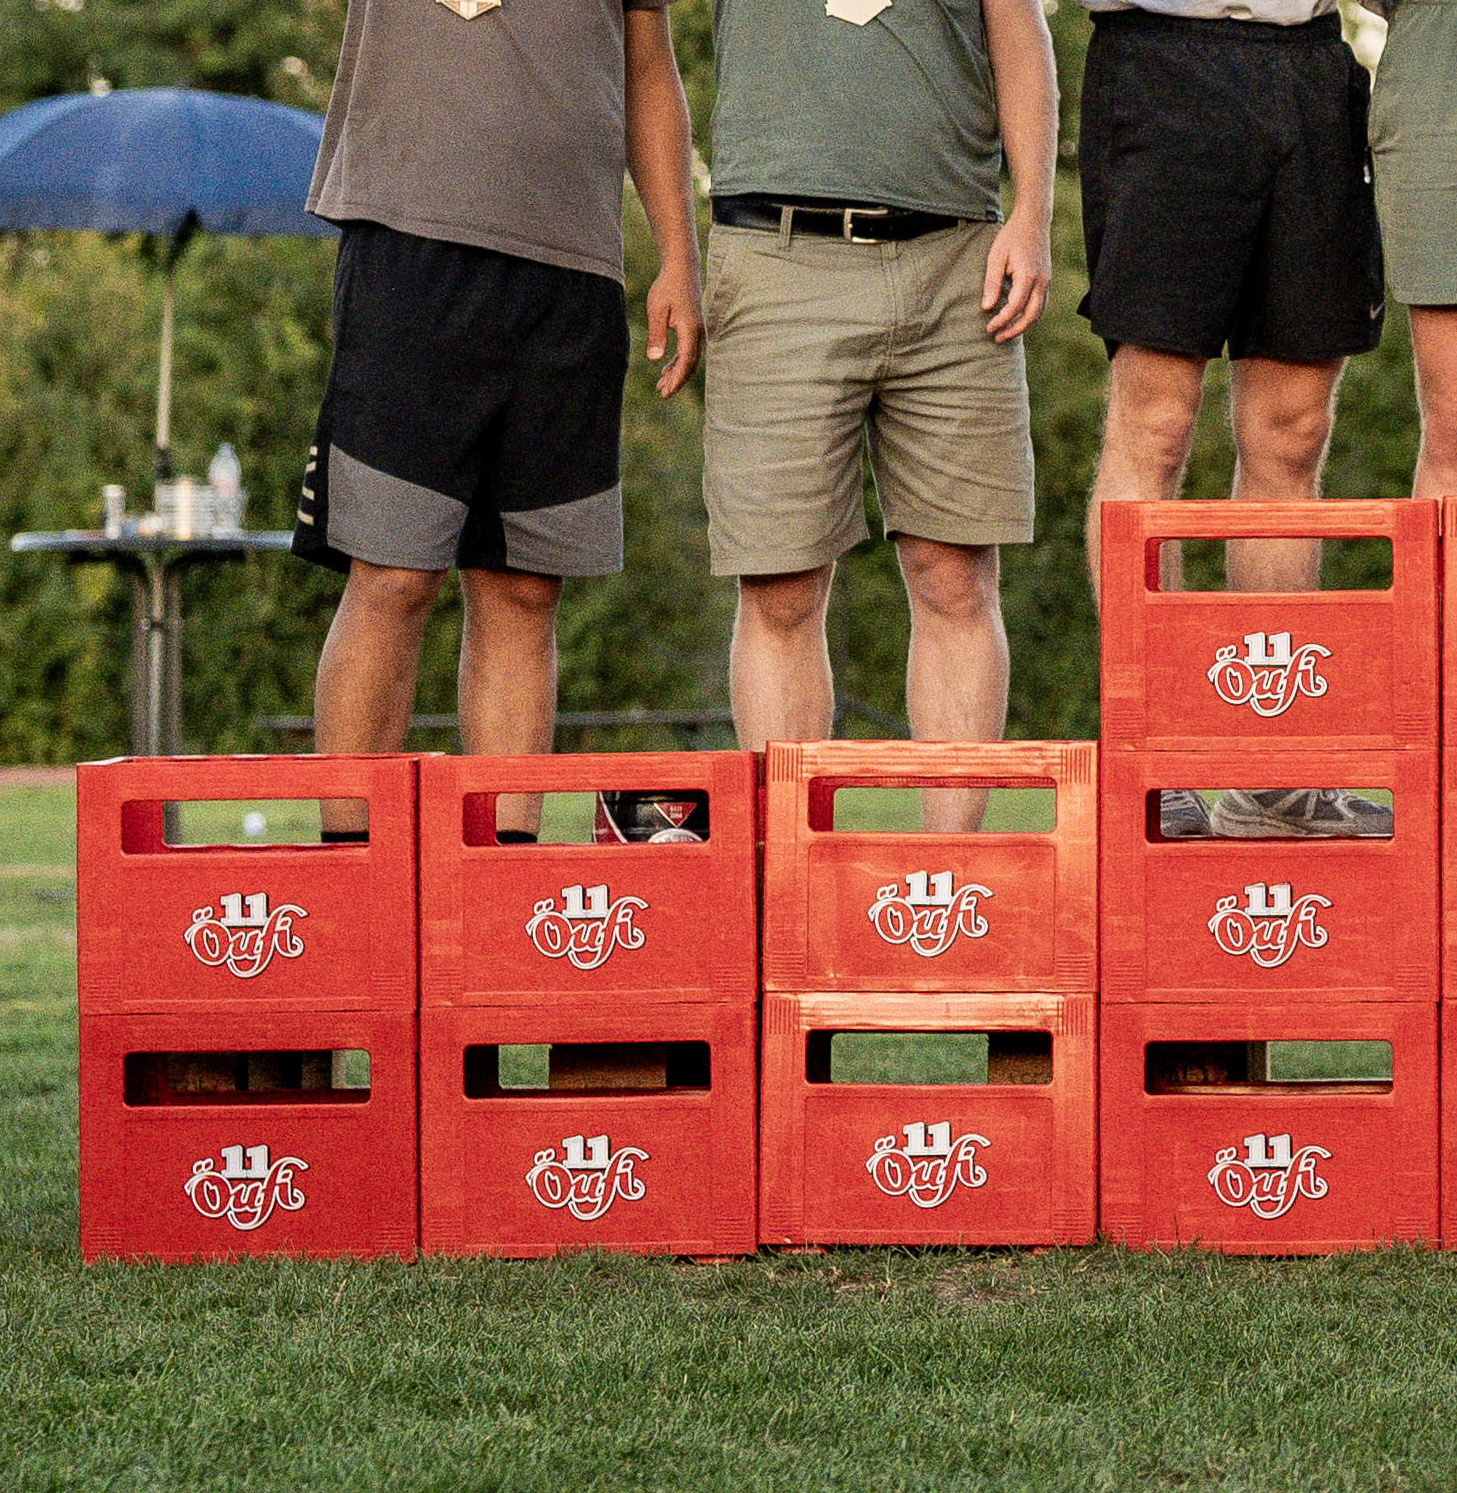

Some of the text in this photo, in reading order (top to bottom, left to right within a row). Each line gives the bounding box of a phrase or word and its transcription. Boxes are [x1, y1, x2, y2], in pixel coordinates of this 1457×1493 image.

[1244, 631, 1293, 666] 11
[562, 884, 611, 919] 11
[904, 870, 953, 905] 11
[1244, 882, 1293, 917] 11
[220, 892, 269, 927] 11
[562, 1134, 611, 1169] 11
[902, 1121, 951, 1156] 11
[1243, 1133, 1292, 1168] 11
[220, 1144, 269, 1179] 11
